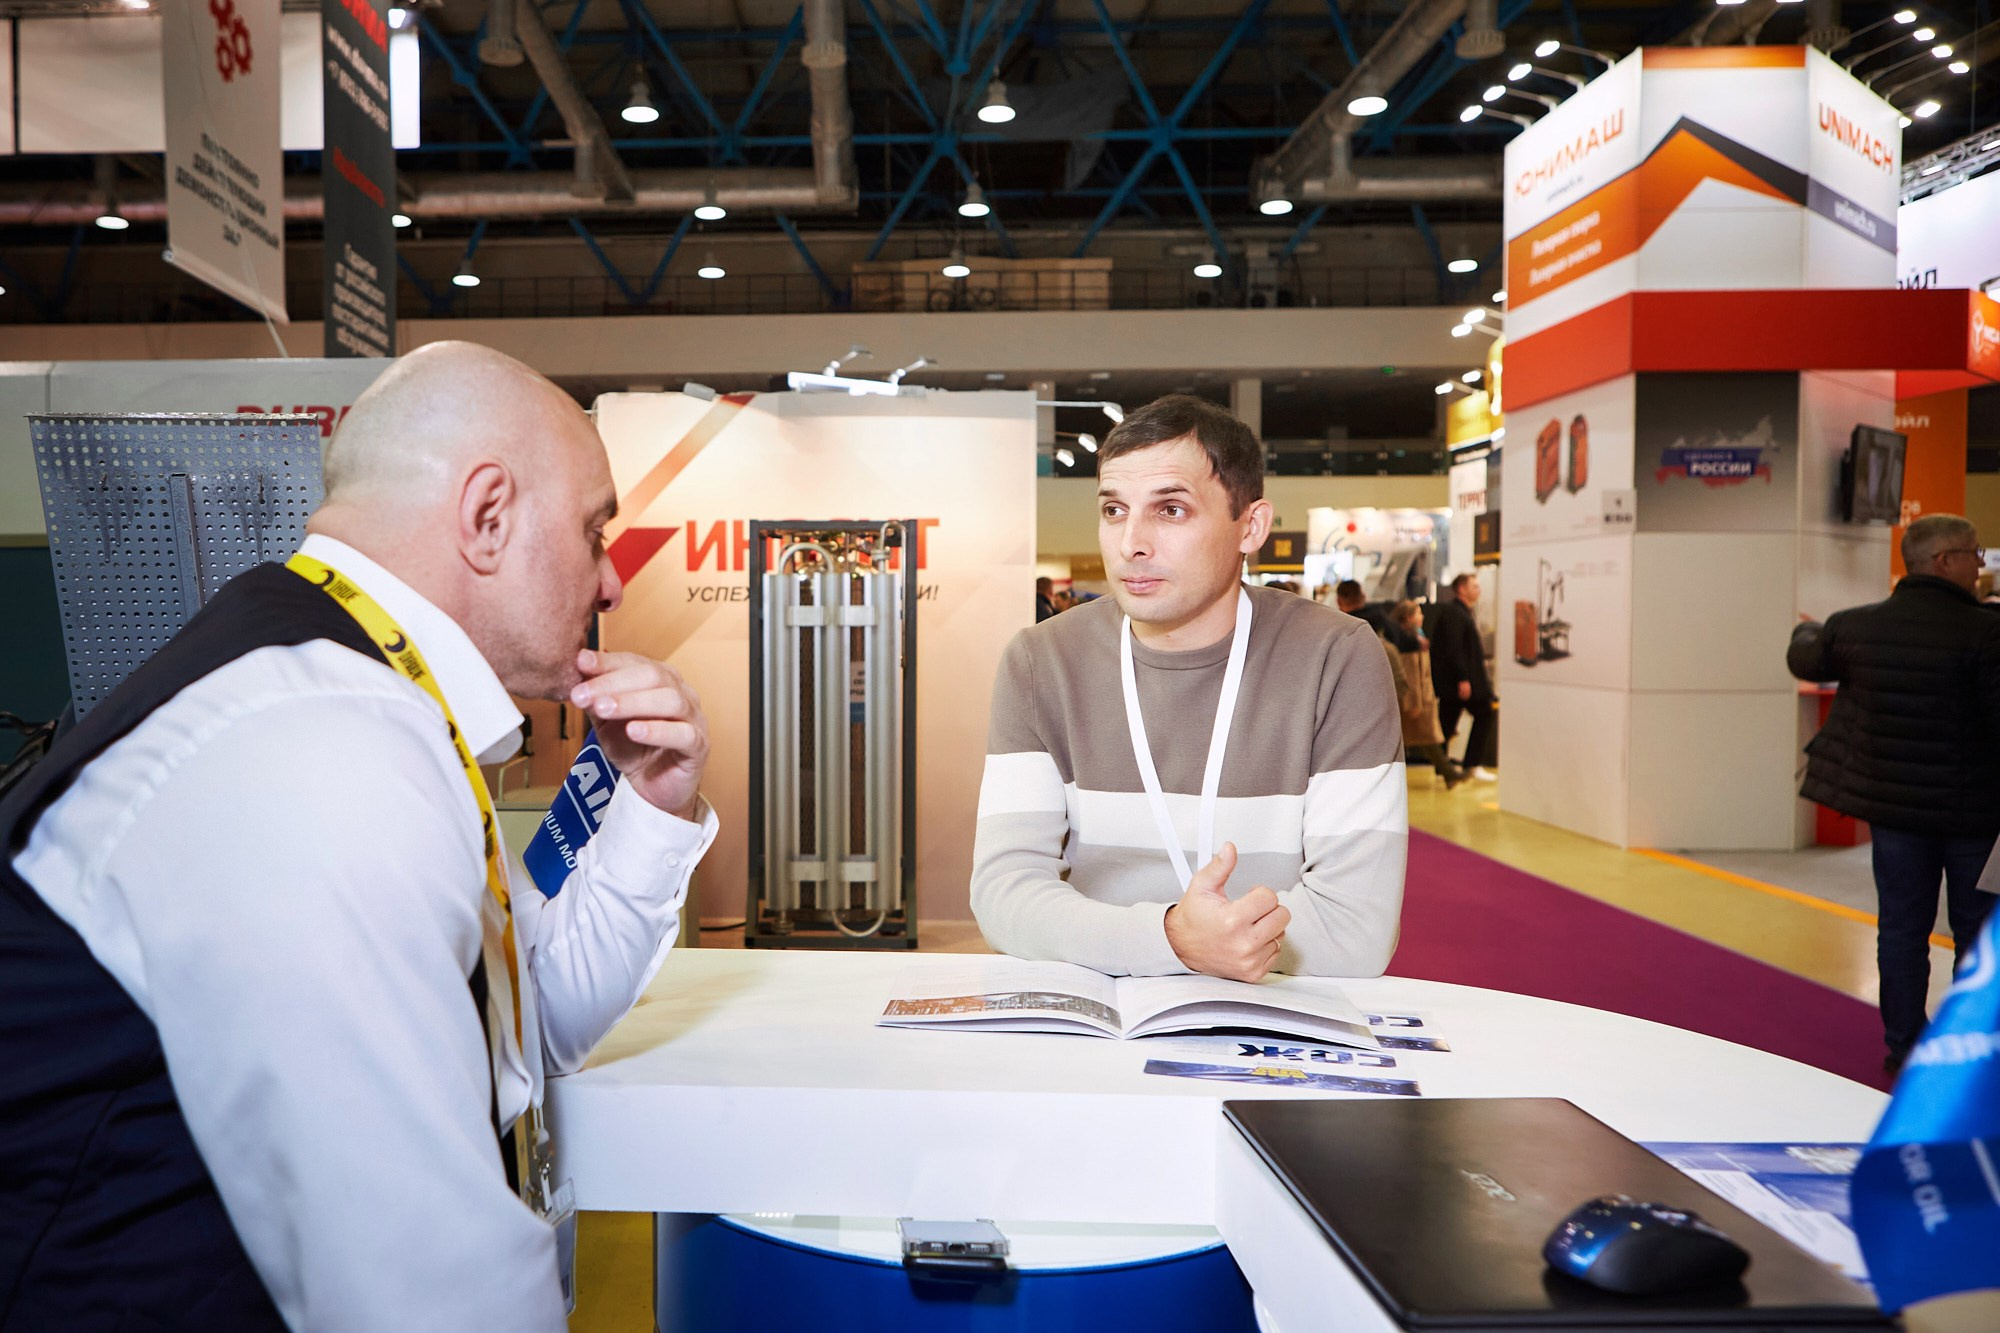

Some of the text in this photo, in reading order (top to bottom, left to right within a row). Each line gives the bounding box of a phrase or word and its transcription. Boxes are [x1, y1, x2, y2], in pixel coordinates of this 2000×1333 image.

[1515, 108, 1625, 196] ЮНИМАШ
[1819, 102, 1894, 174] UNIMACH
[1690, 461, 1752, 475] РОССИИ
